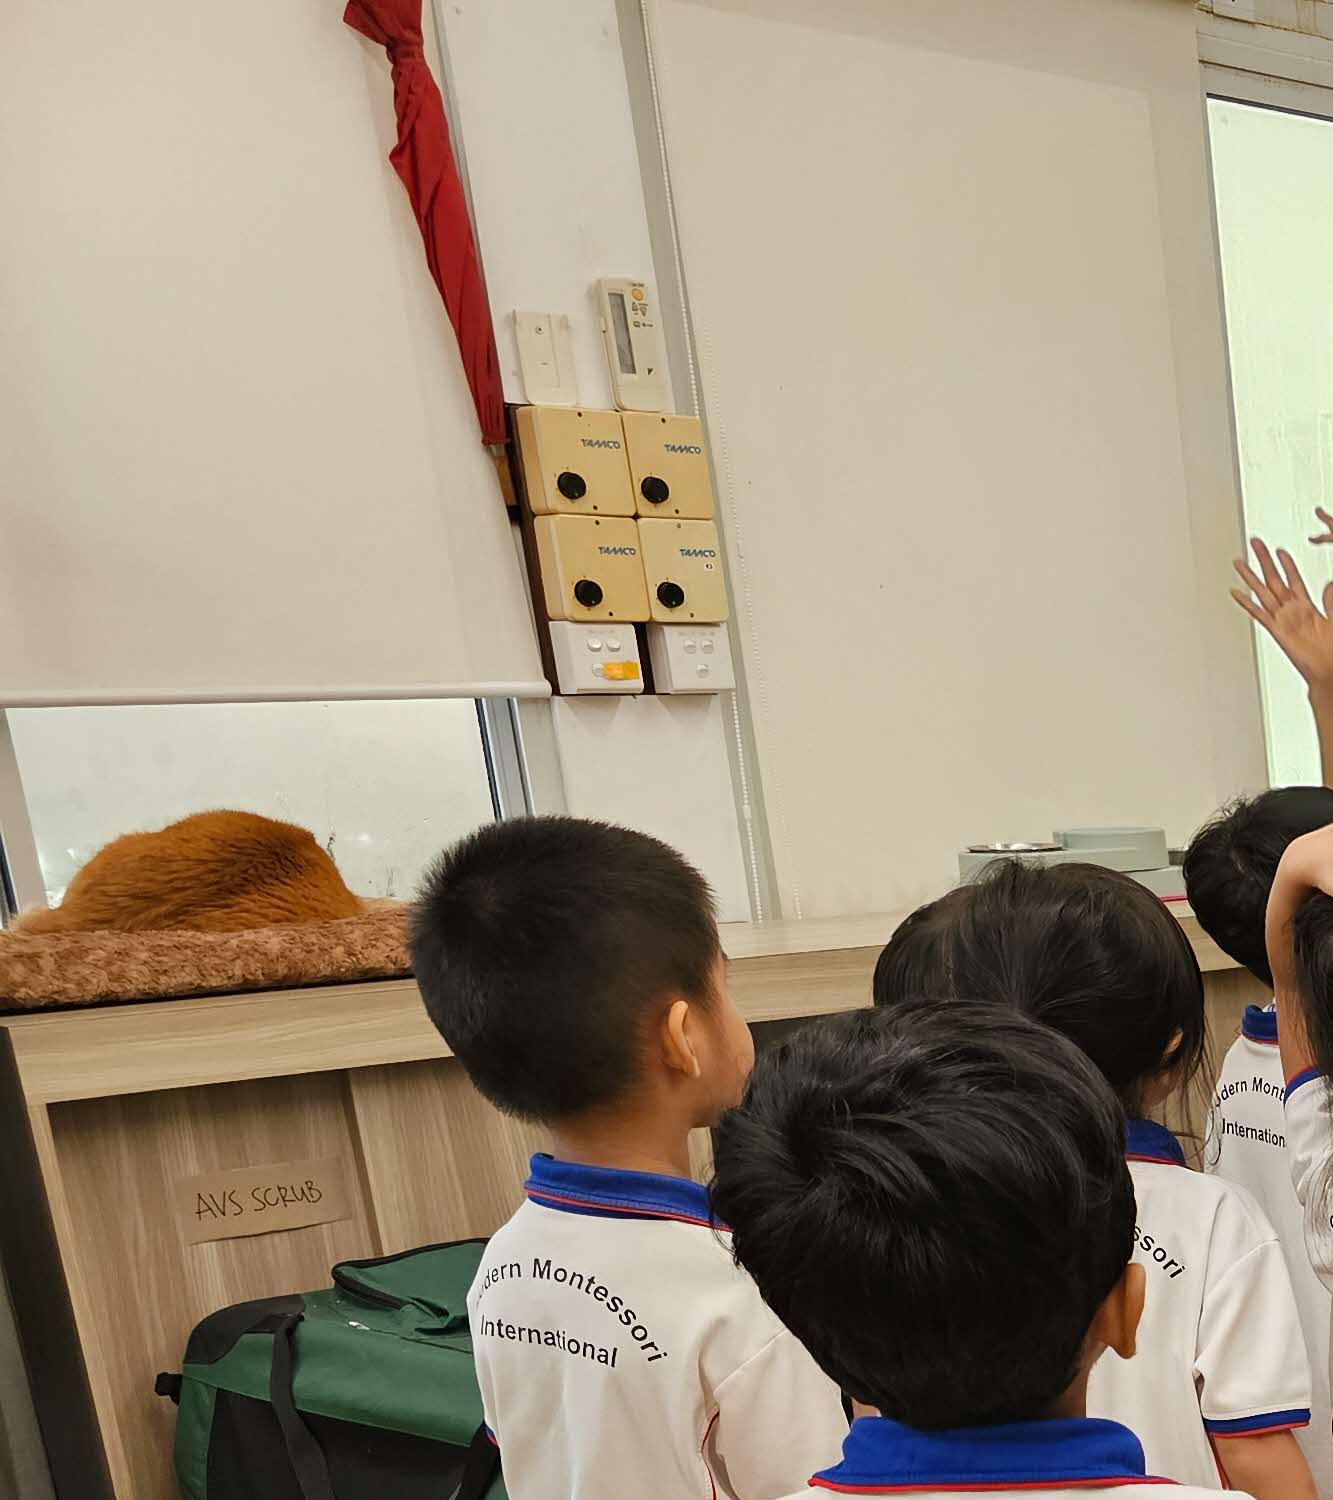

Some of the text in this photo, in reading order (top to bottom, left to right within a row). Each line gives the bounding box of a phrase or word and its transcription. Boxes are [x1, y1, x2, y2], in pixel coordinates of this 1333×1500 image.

[1222, 1118, 1286, 1148] Internation
[195, 1180, 323, 1221] AVS SCRUB
[1133, 1225, 1186, 1279] ssori
[476, 1258, 668, 1362] dern Montessori
[480, 1314, 618, 1368] International
